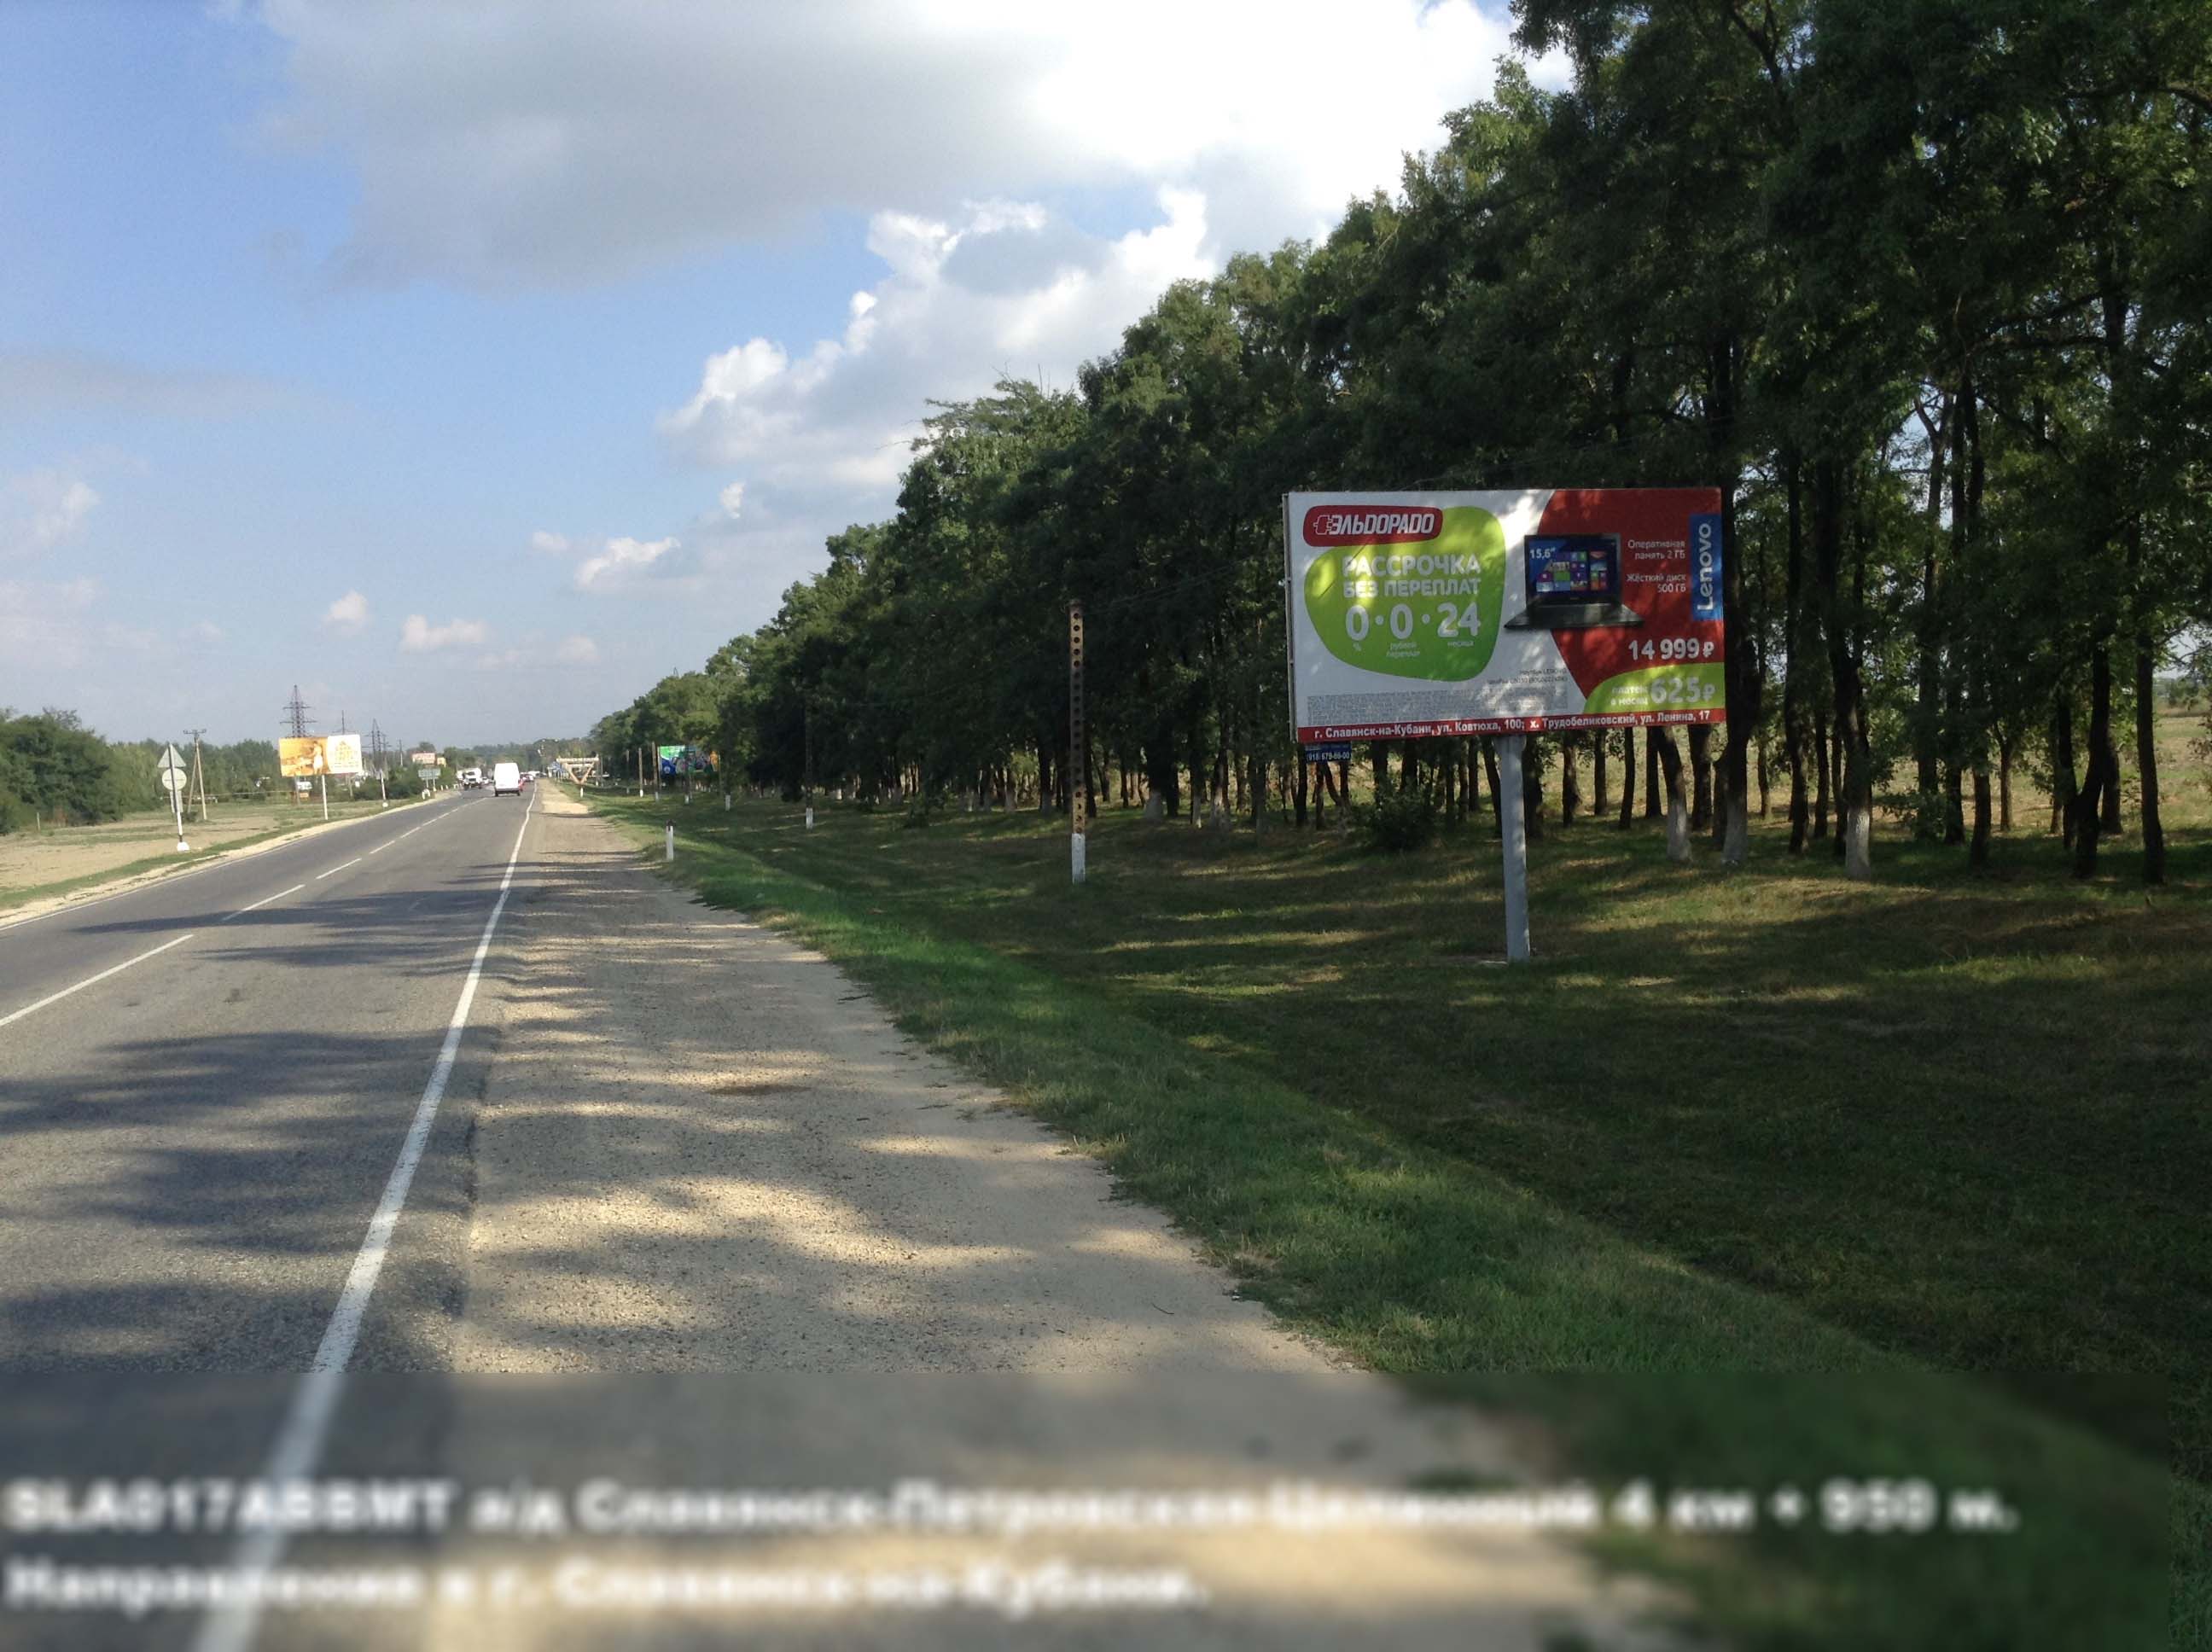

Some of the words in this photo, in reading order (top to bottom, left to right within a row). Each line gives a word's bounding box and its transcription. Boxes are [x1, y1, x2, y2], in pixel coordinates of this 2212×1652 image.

[1342, 553, 1481, 577] РАССРОЧКА
[1667, 550, 1674, 560] 2
[1674, 550, 1685, 560] ГБ
[1697, 522, 1714, 611] Lenovo
[1343, 579, 1379, 598] БЕЗ
[1384, 578, 1481, 597] ПЕРЕПЛАТ
[1657, 584, 1674, 594] 500
[1675, 583, 1686, 593] ГБ
[1628, 639, 1656, 660] 14
[1314, 729, 1323, 739] г.
[1325, 723, 1435, 739] Славянск-на-Кубани,
[1437, 725, 1452, 738] ул.
[1640, 714, 1655, 725] ул.
[1657, 712, 1697, 724] Ленина,
[1698, 710, 1711, 720] 17
